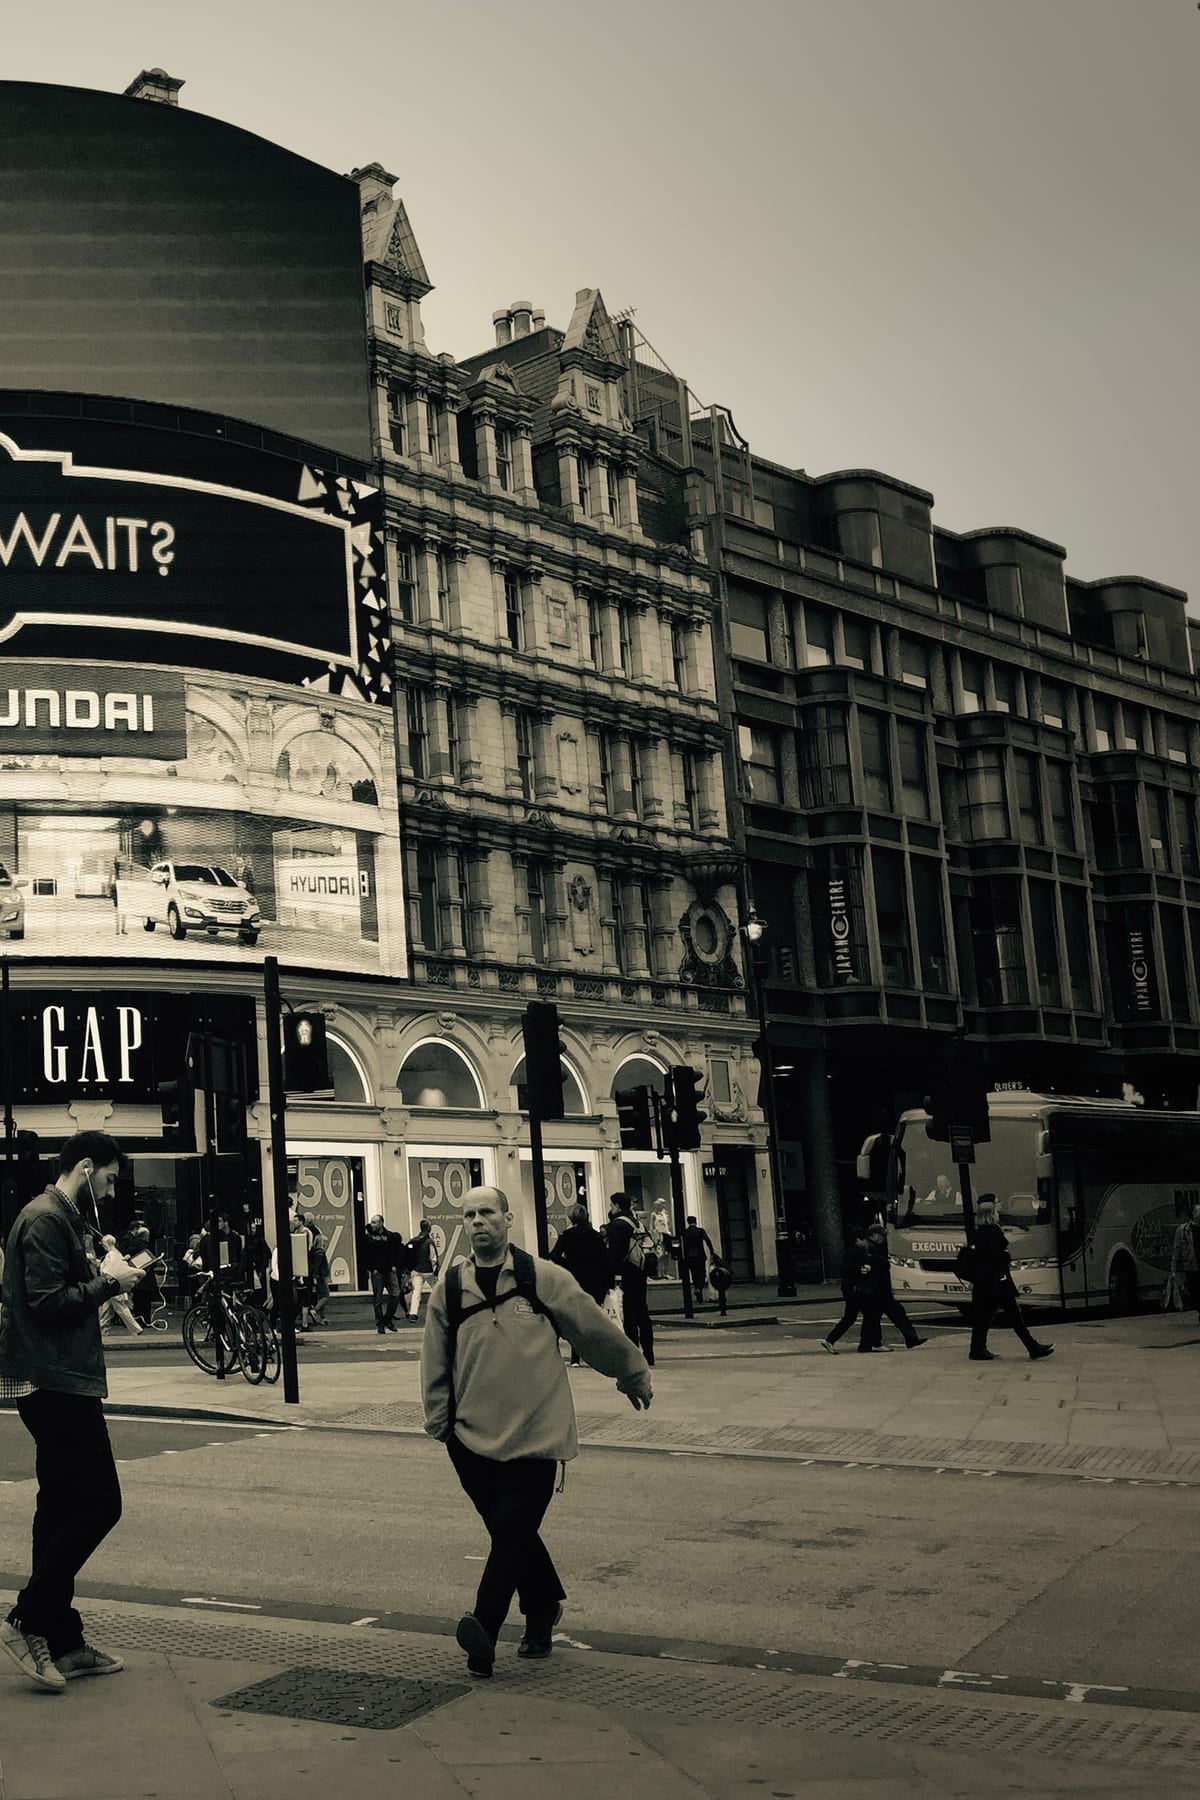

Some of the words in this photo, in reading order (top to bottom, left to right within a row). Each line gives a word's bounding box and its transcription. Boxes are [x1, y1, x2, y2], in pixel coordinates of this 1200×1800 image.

[290, 875, 355, 896] HYUNDAI
[828, 880, 850, 940] CENTRE
[834, 940, 854, 974] JAPAN
[42, 1005, 142, 1083] GAP
[298, 1160, 349, 1208] 50
[420, 1162, 467, 1208] 50
